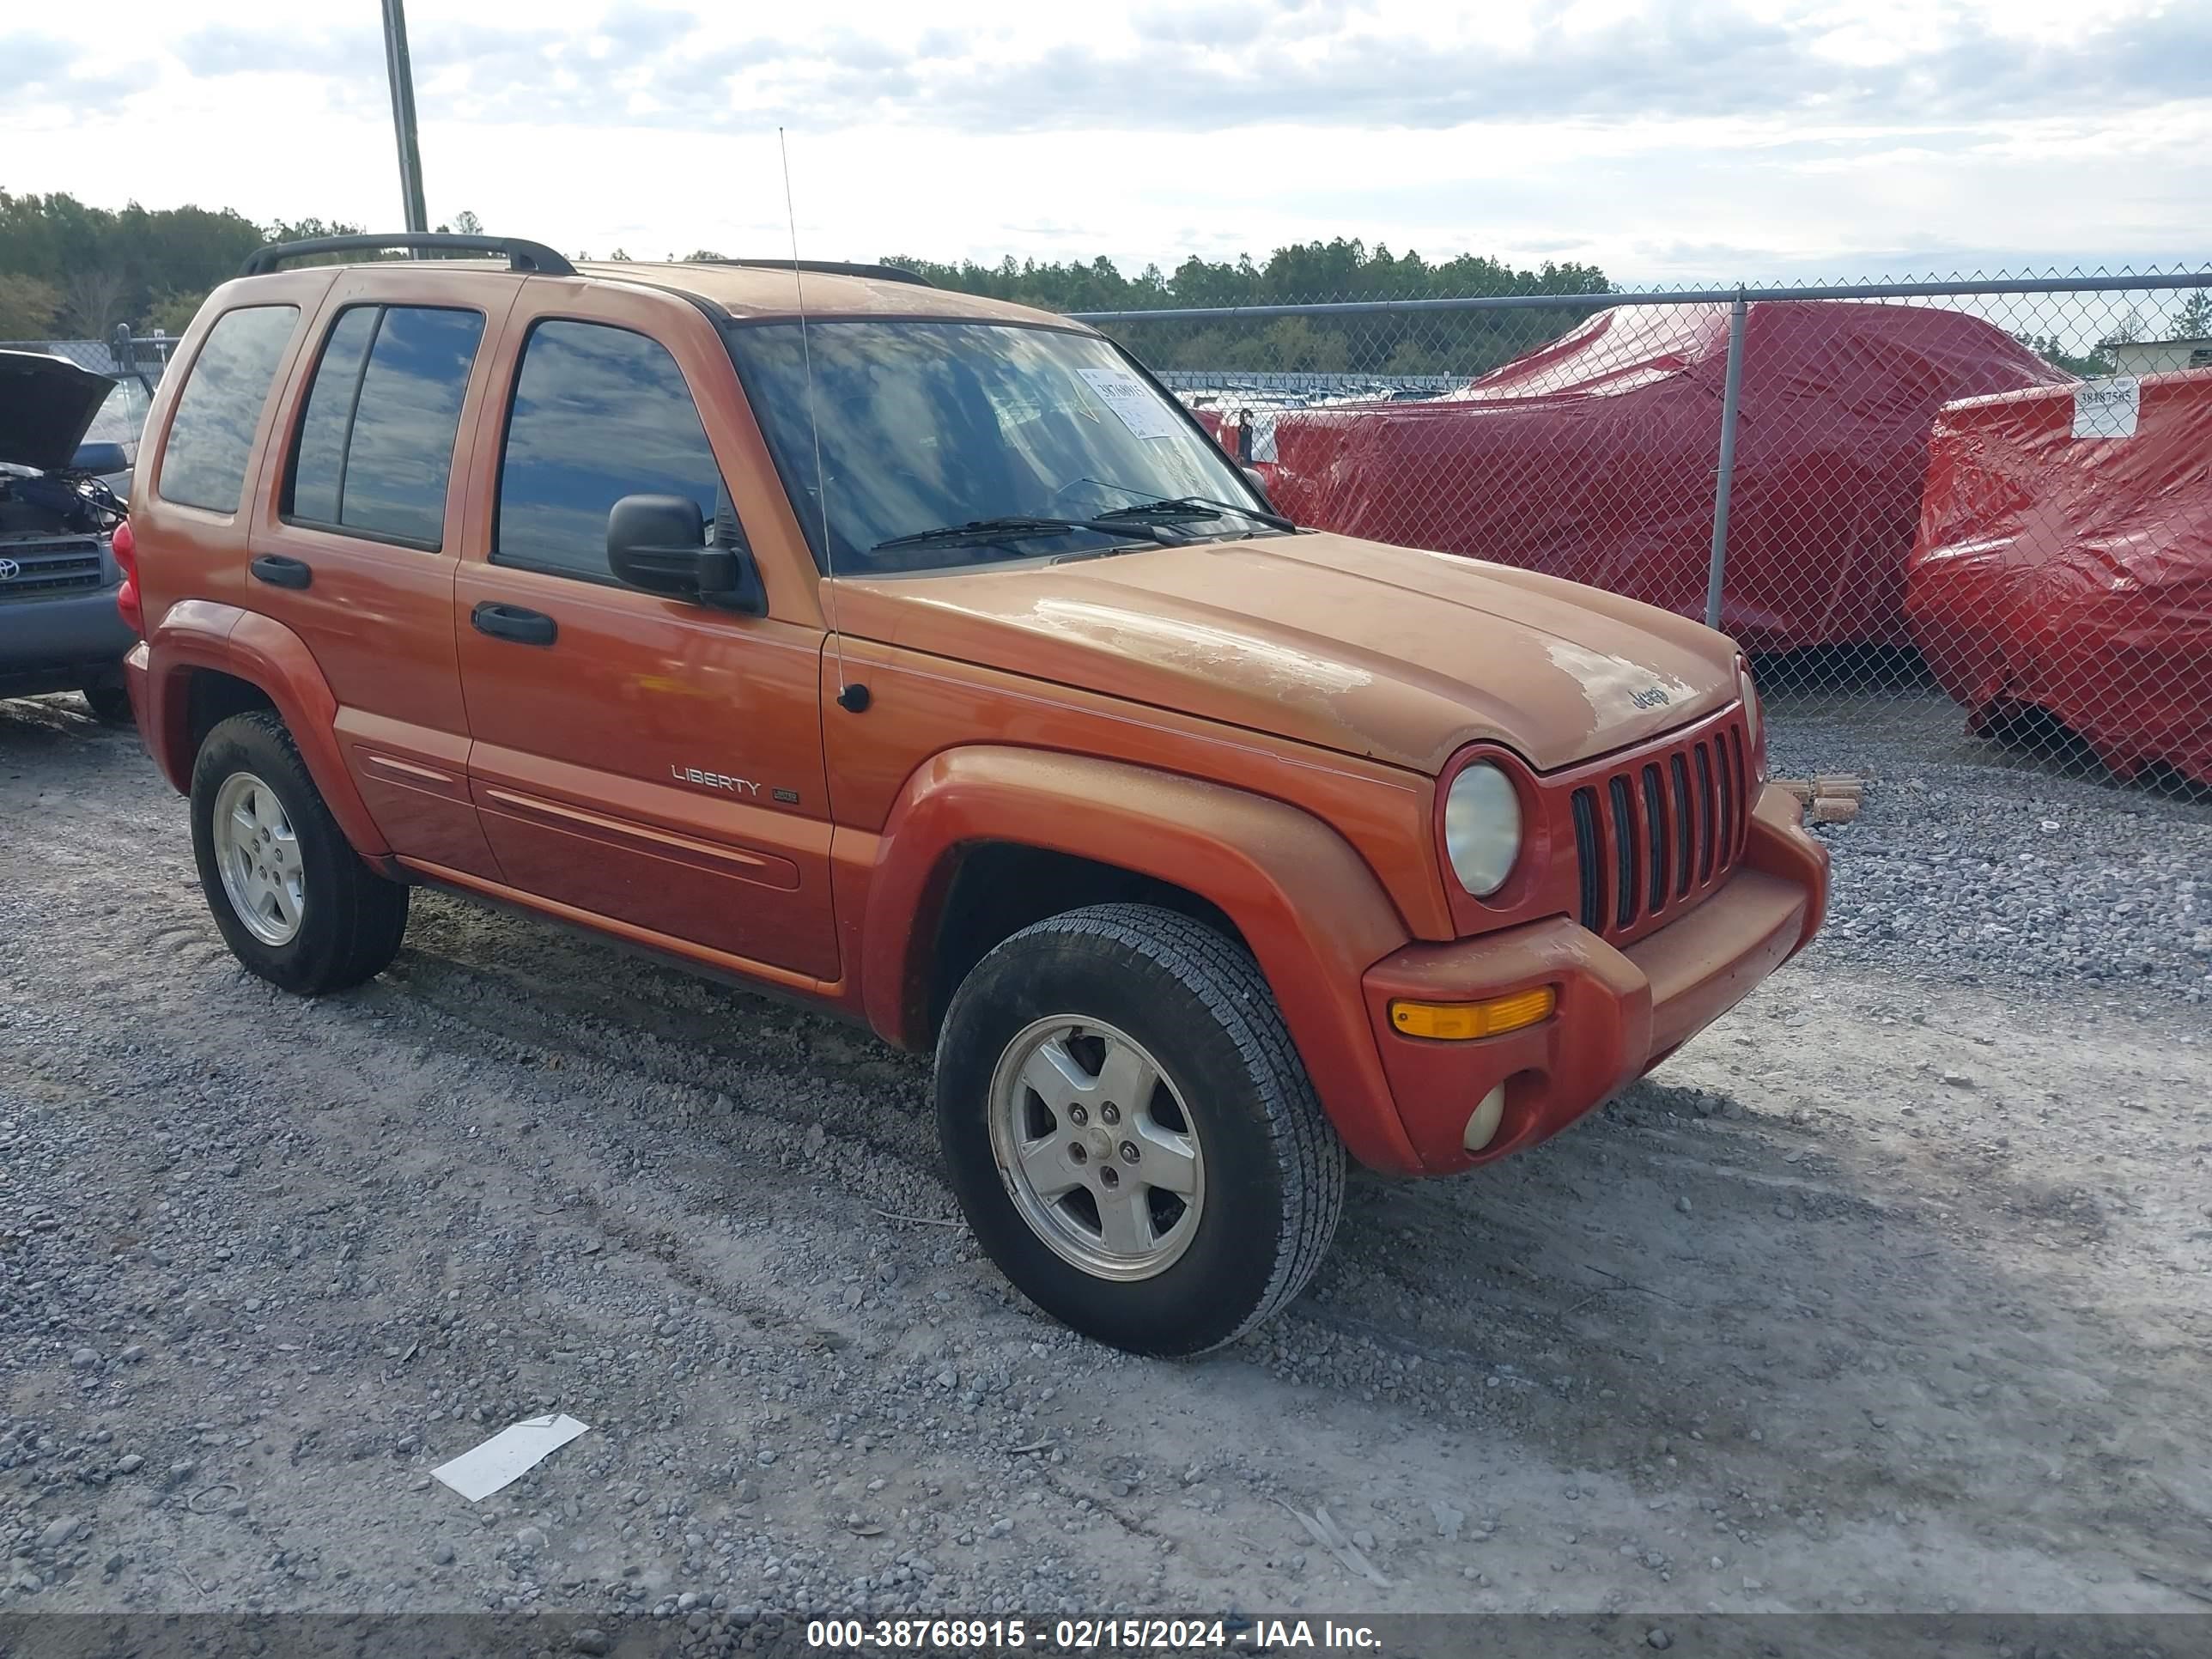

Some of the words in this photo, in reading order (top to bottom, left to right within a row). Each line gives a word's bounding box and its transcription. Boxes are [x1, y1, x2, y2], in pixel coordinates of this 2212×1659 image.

[1097, 384, 1146, 398] 38768915
[1627, 687, 1669, 709] Jeep
[671, 764, 762, 797] LIBERTY
